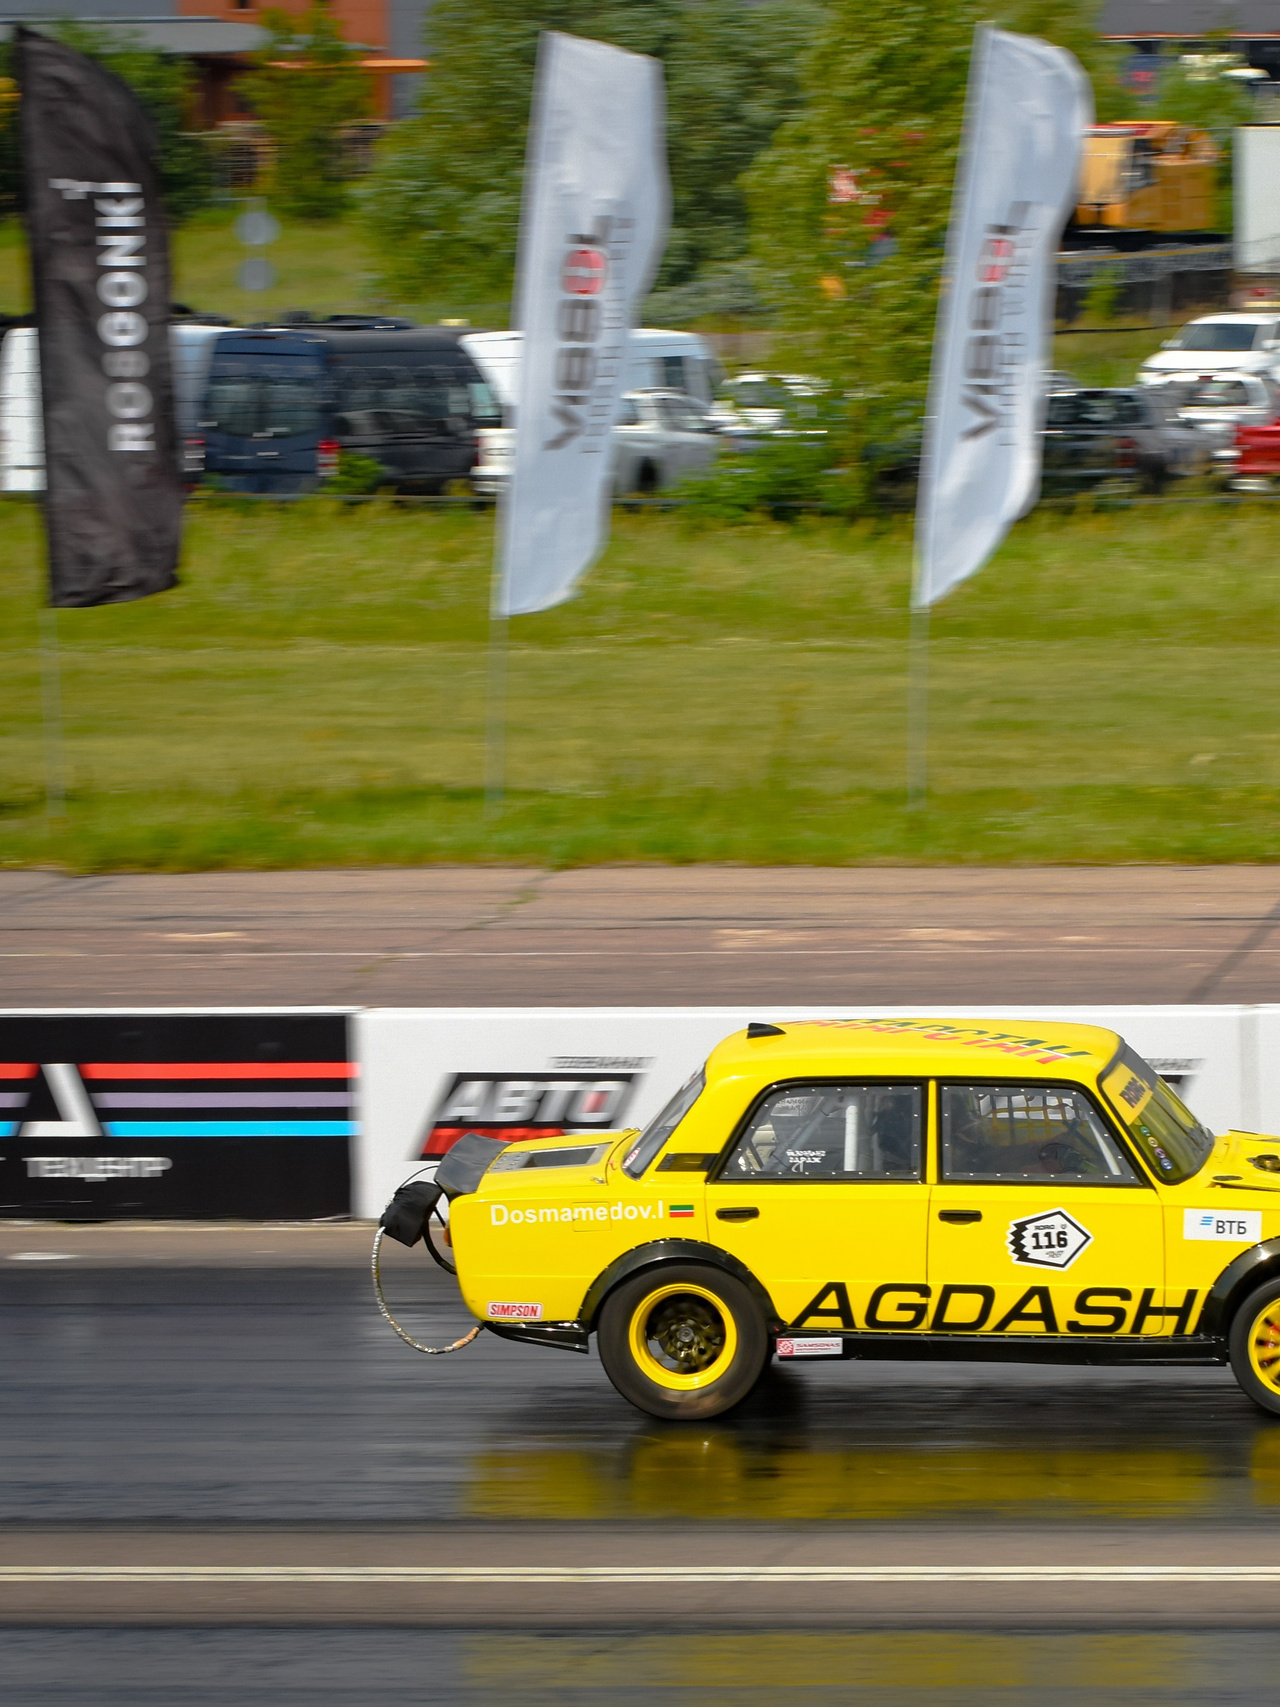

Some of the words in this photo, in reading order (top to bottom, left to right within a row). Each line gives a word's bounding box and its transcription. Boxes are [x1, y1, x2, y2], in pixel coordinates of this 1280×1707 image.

[438, 1080, 632, 1123] АВТО
[490, 1200, 664, 1226] Dosmamedov.I
[1215, 1220, 1247, 1235] ВТБ
[1031, 1231, 1068, 1250] 116
[489, 1303, 539, 1317] SIMPSON
[789, 1281, 1199, 1335] AGDASH
